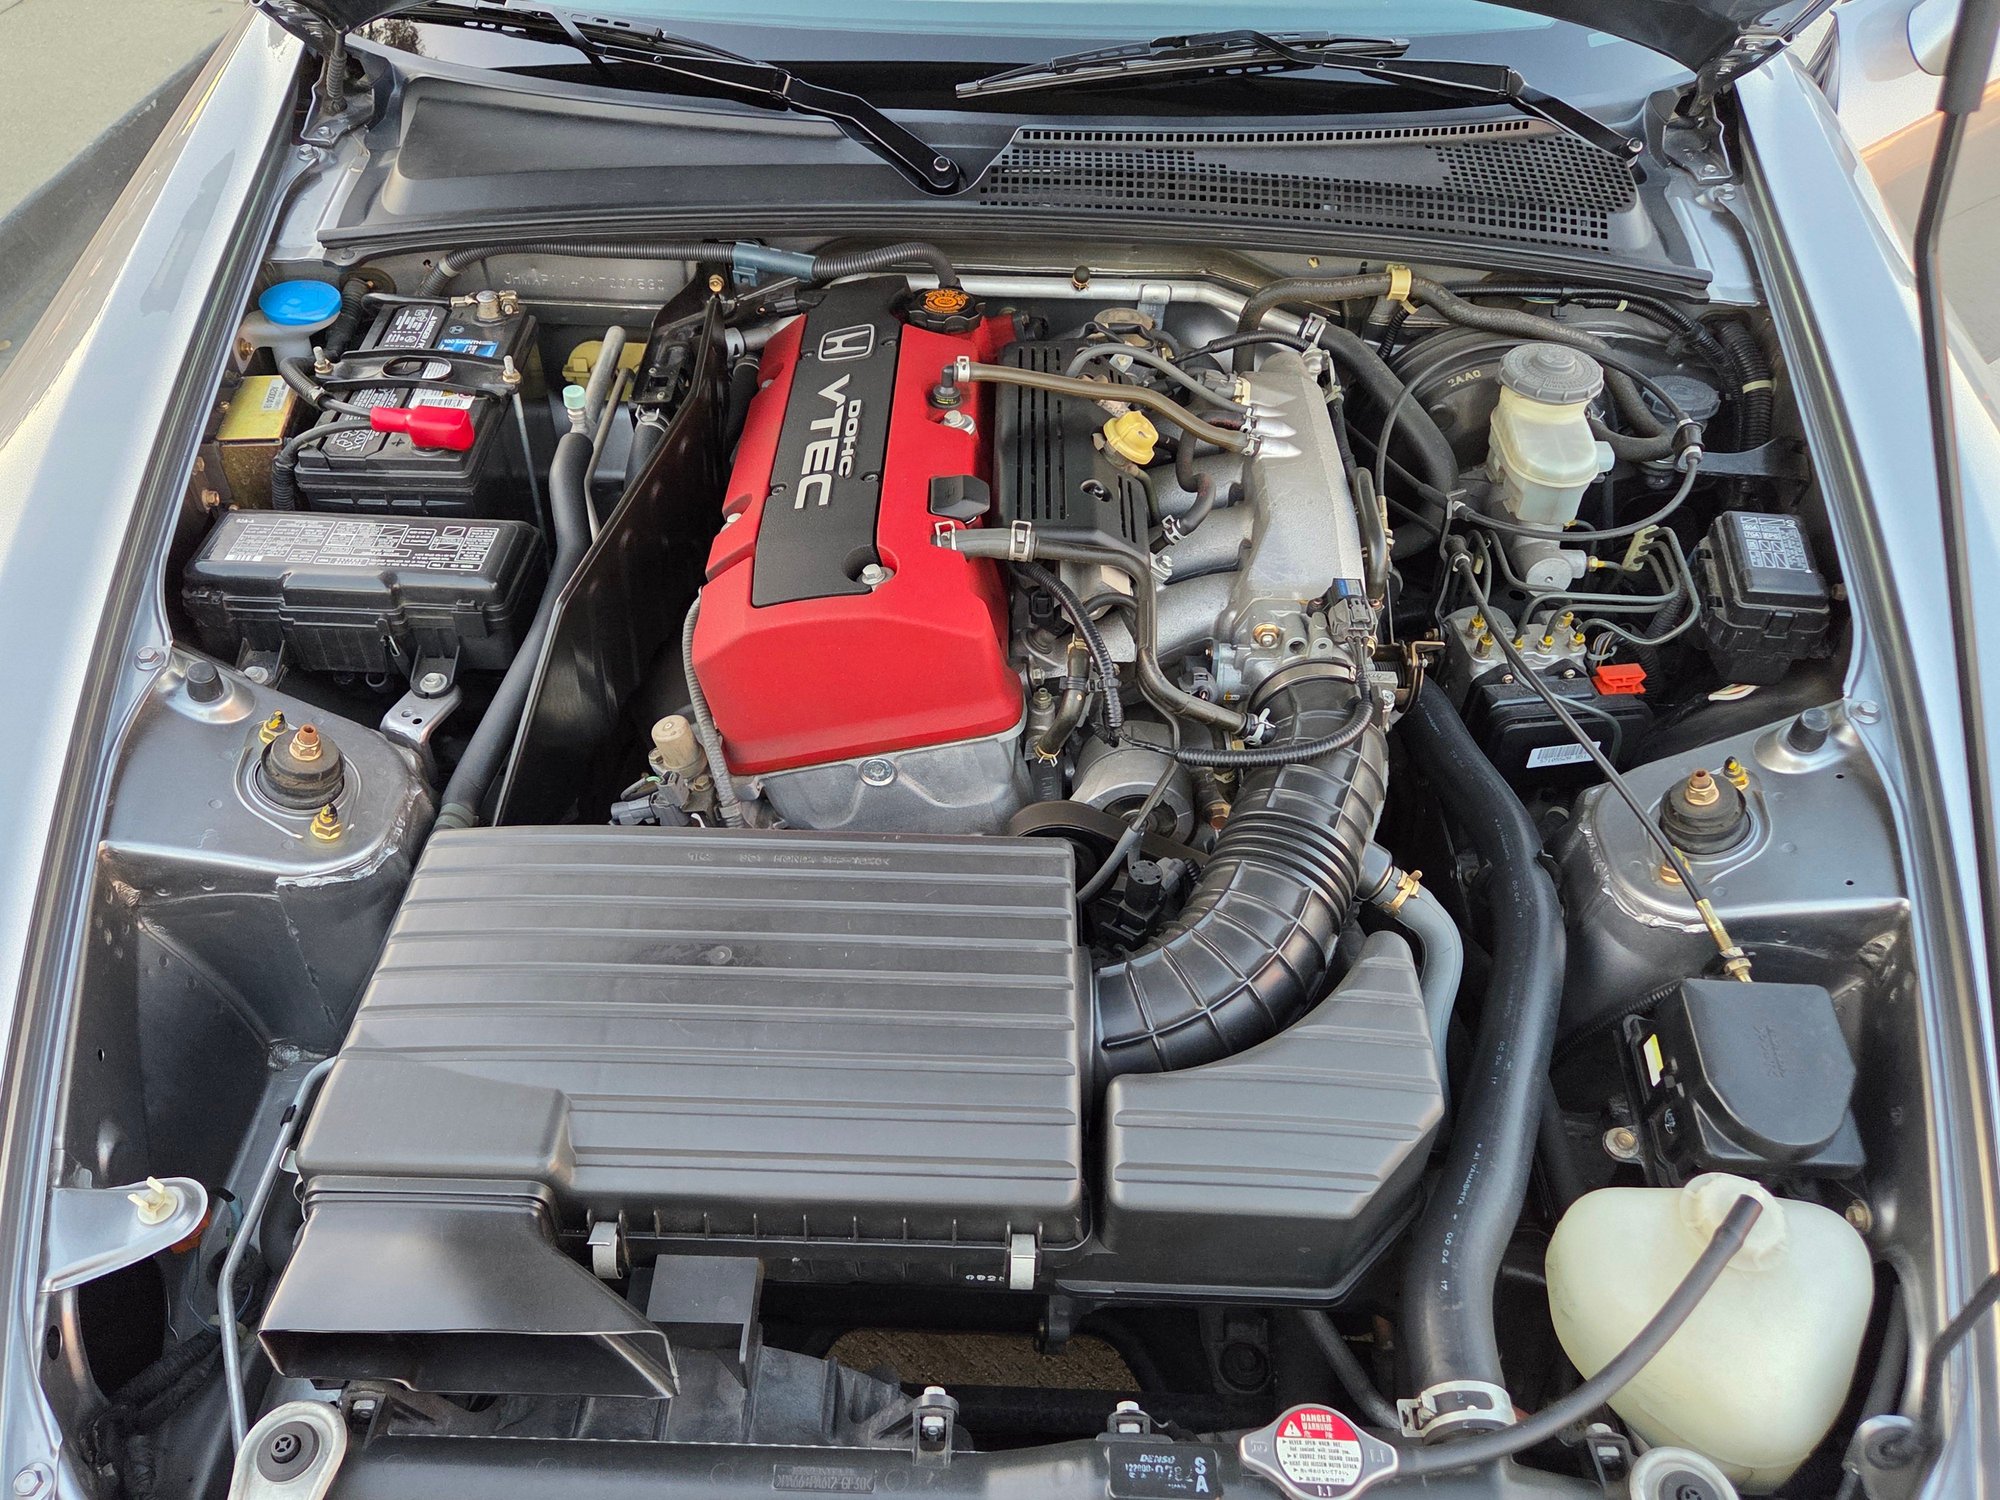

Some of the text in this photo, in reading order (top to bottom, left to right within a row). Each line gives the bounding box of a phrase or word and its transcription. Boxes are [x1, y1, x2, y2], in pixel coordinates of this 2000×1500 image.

[794, 373, 850, 509] VTEC
[838, 399, 861, 478] DOHC
[1300, 1413, 1332, 1422] DANGER
[1302, 1422, 1333, 1431] WARNING
[1140, 1454, 1176, 1464] DENSO
[1317, 1484, 1331, 1497] 1.1
